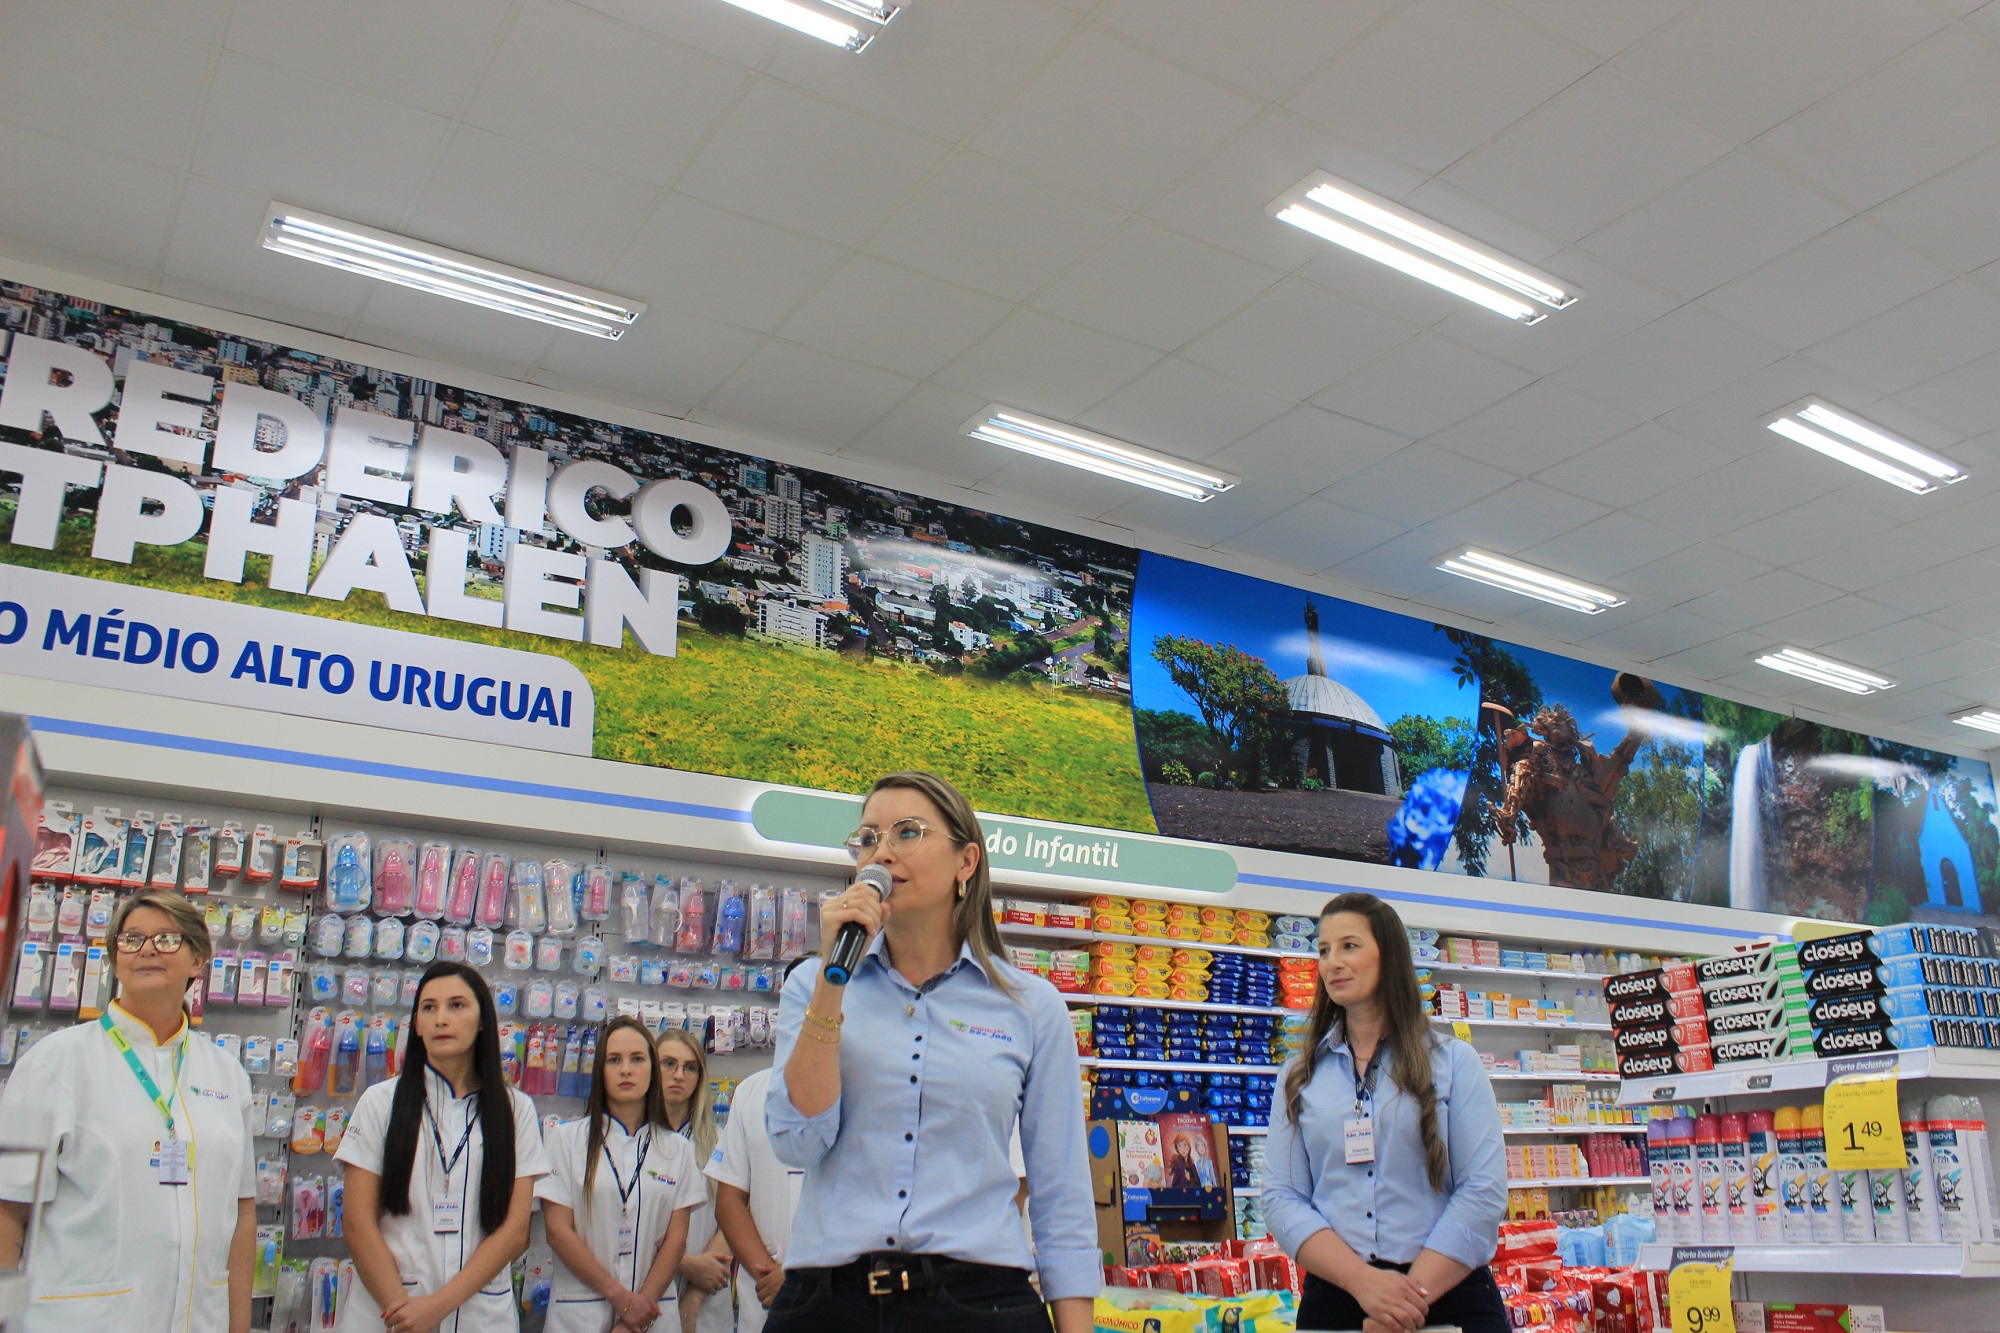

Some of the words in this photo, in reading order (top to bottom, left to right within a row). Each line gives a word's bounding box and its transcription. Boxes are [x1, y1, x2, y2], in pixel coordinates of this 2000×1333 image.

[0, 330, 732, 565] REDERICO
[0, 441, 679, 658] TPHALEN
[42, 608, 219, 674] MÉDIO
[230, 639, 356, 695] ALTO
[369, 660, 573, 728] URUGUAI
[983, 827, 1018, 856] do
[1024, 831, 1119, 868] Infantil
[1804, 940, 1863, 961] closeup
[1702, 956, 1756, 976] closeup
[1608, 976, 1657, 996] closeup
[1812, 970, 1873, 990] closeup
[1709, 984, 1763, 1003] closeup
[1614, 1003, 1664, 1021] closeup
[1815, 1000, 1876, 1020] closeup
[1713, 1012, 1767, 1031] closeup
[989, 1033, 1012, 1042] João
[1619, 1029, 1668, 1047] closeup
[1821, 1030, 1882, 1050] closeup
[1717, 1040, 1771, 1058] closeup
[1623, 1056, 1673, 1074] closeup
[1832, 1063, 1855, 1074] Oferta
[1856, 1059, 1893, 1070] Exclusiva!
[1779, 1140, 1801, 1148] ABOVE
[1785, 1162, 1797, 1171] 72h
[1808, 1161, 1819, 1169] 72h
[1937, 1155, 1949, 1164] 72h
[1677, 1251, 1697, 1260] Oferta
[1697, 1249, 1729, 1258] Exclusiva!
[1287, 1258, 1302, 1300] UGGIES
[1094, 1316, 1140, 1331] ECONÔMICO
